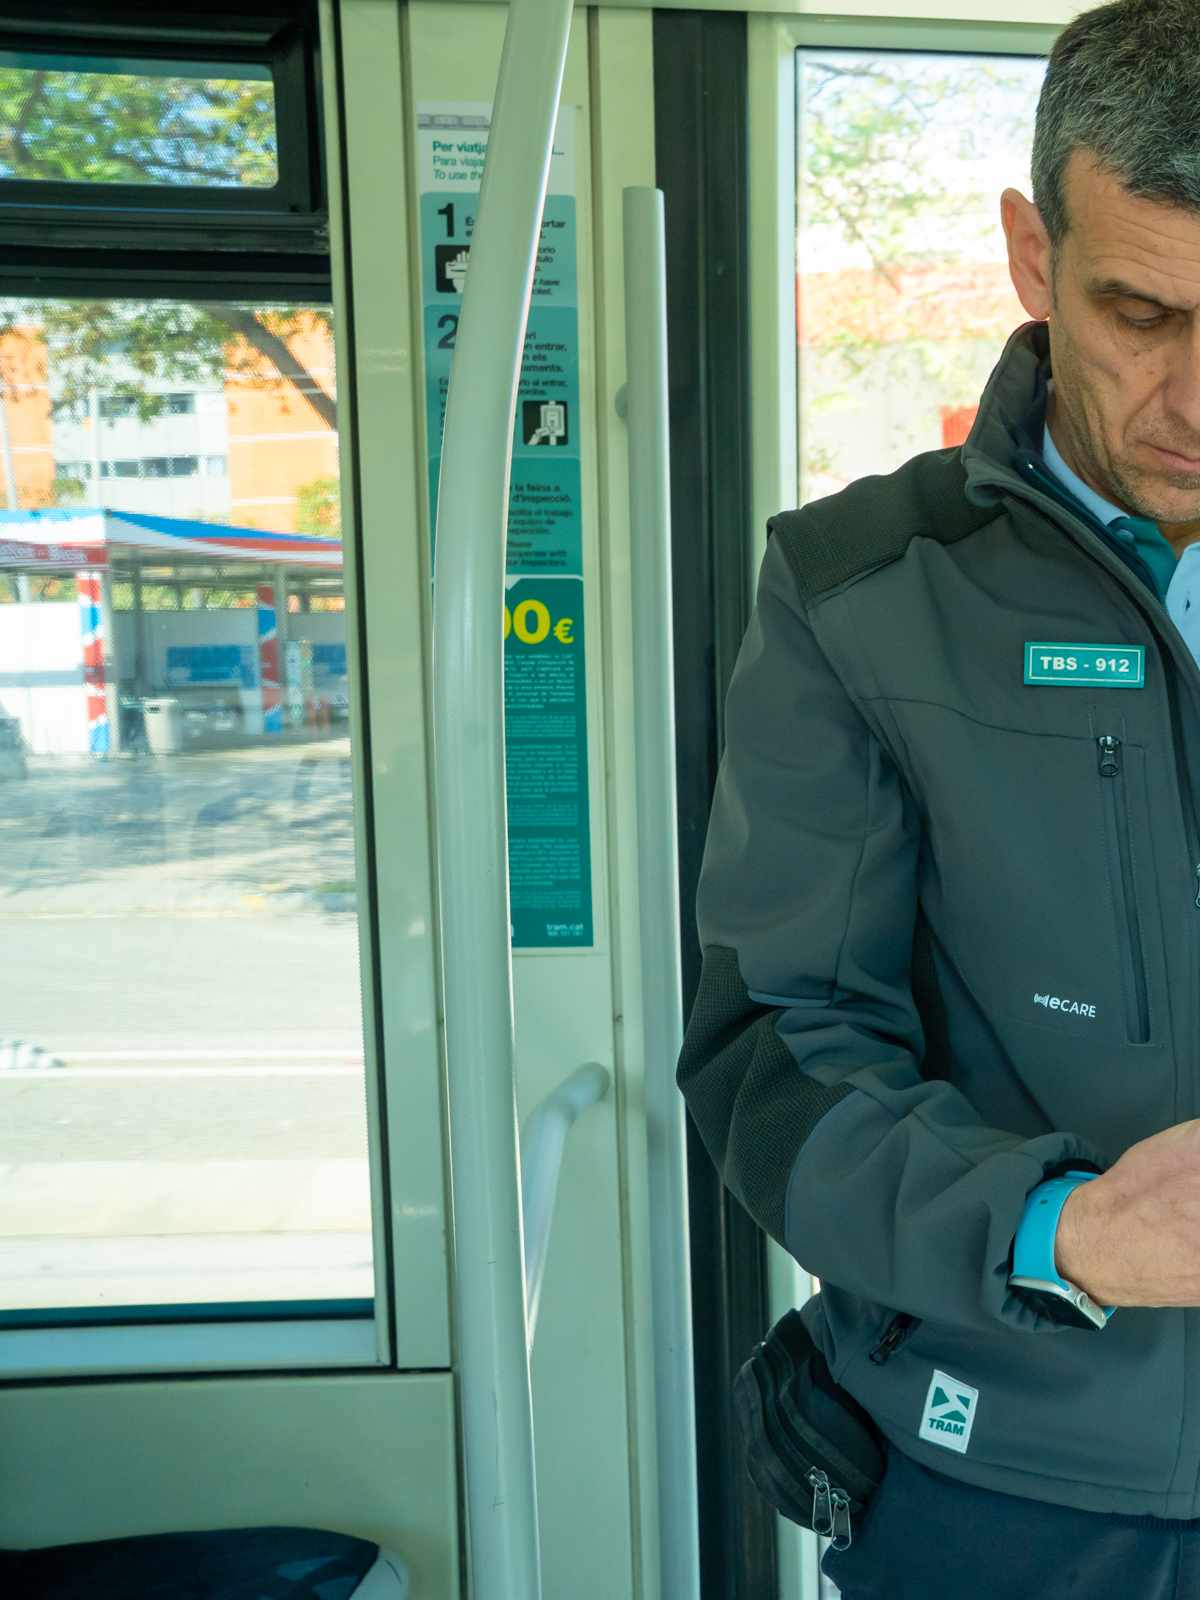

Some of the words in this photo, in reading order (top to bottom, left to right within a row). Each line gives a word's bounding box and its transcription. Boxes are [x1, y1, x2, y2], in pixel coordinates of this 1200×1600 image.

[432, 141, 453, 152] Per
[456, 141, 487, 155] viatja
[433, 155, 457, 166] Para
[459, 156, 485, 169] viaja
[434, 169, 446, 180] To
[448, 171, 468, 180] use
[470, 170, 482, 180] th
[437, 203, 455, 238] 1
[541, 220, 566, 229] ortar
[437, 315, 459, 348] 2
[534, 342, 567, 352] entrar,
[521, 364, 565, 373] aments.
[526, 483, 551, 492] feina
[1040, 656, 1078, 670] TBS
[1095, 658, 1130, 673] 912
[928, 1417, 965, 1436] TRAM
